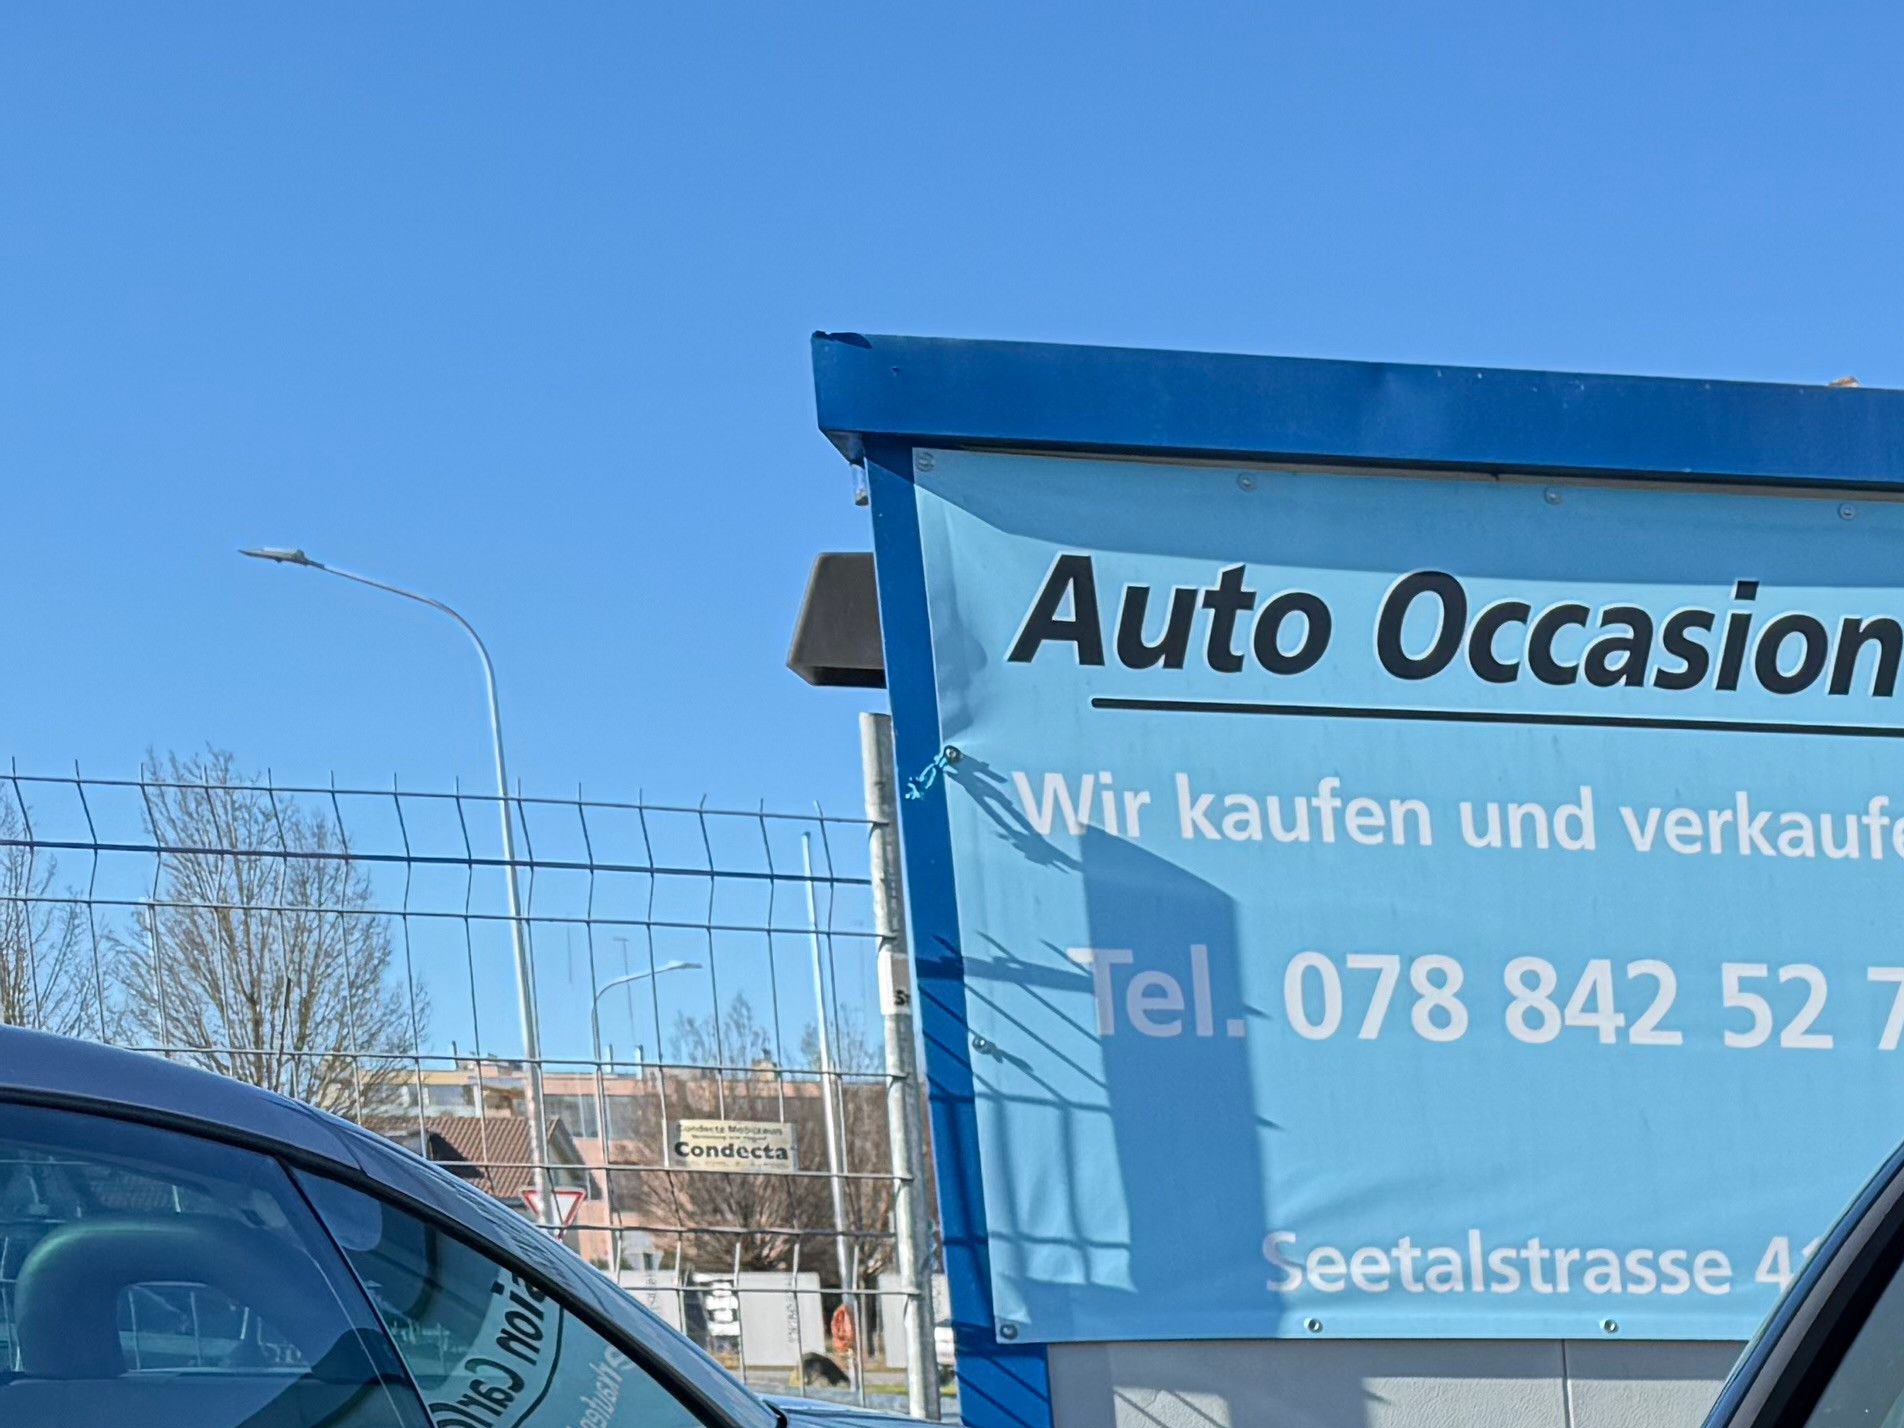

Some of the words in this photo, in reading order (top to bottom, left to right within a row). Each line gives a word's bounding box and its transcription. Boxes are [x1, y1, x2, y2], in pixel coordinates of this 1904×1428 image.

[1008, 554, 1332, 676] Auto
[1375, 570, 1904, 698] Occasion
[1012, 771, 1151, 838] Wir
[1176, 773, 1433, 848] kaufen
[1461, 786, 1594, 852] und
[1067, 945, 1247, 1038] Tel.
[1283, 951, 1468, 1043] 078
[1504, 958, 1683, 1048] 842
[1722, 964, 1834, 1050] 52
[674, 1141, 789, 1160] Condecta
[1261, 1228, 1733, 1296] Seetalstrasse
